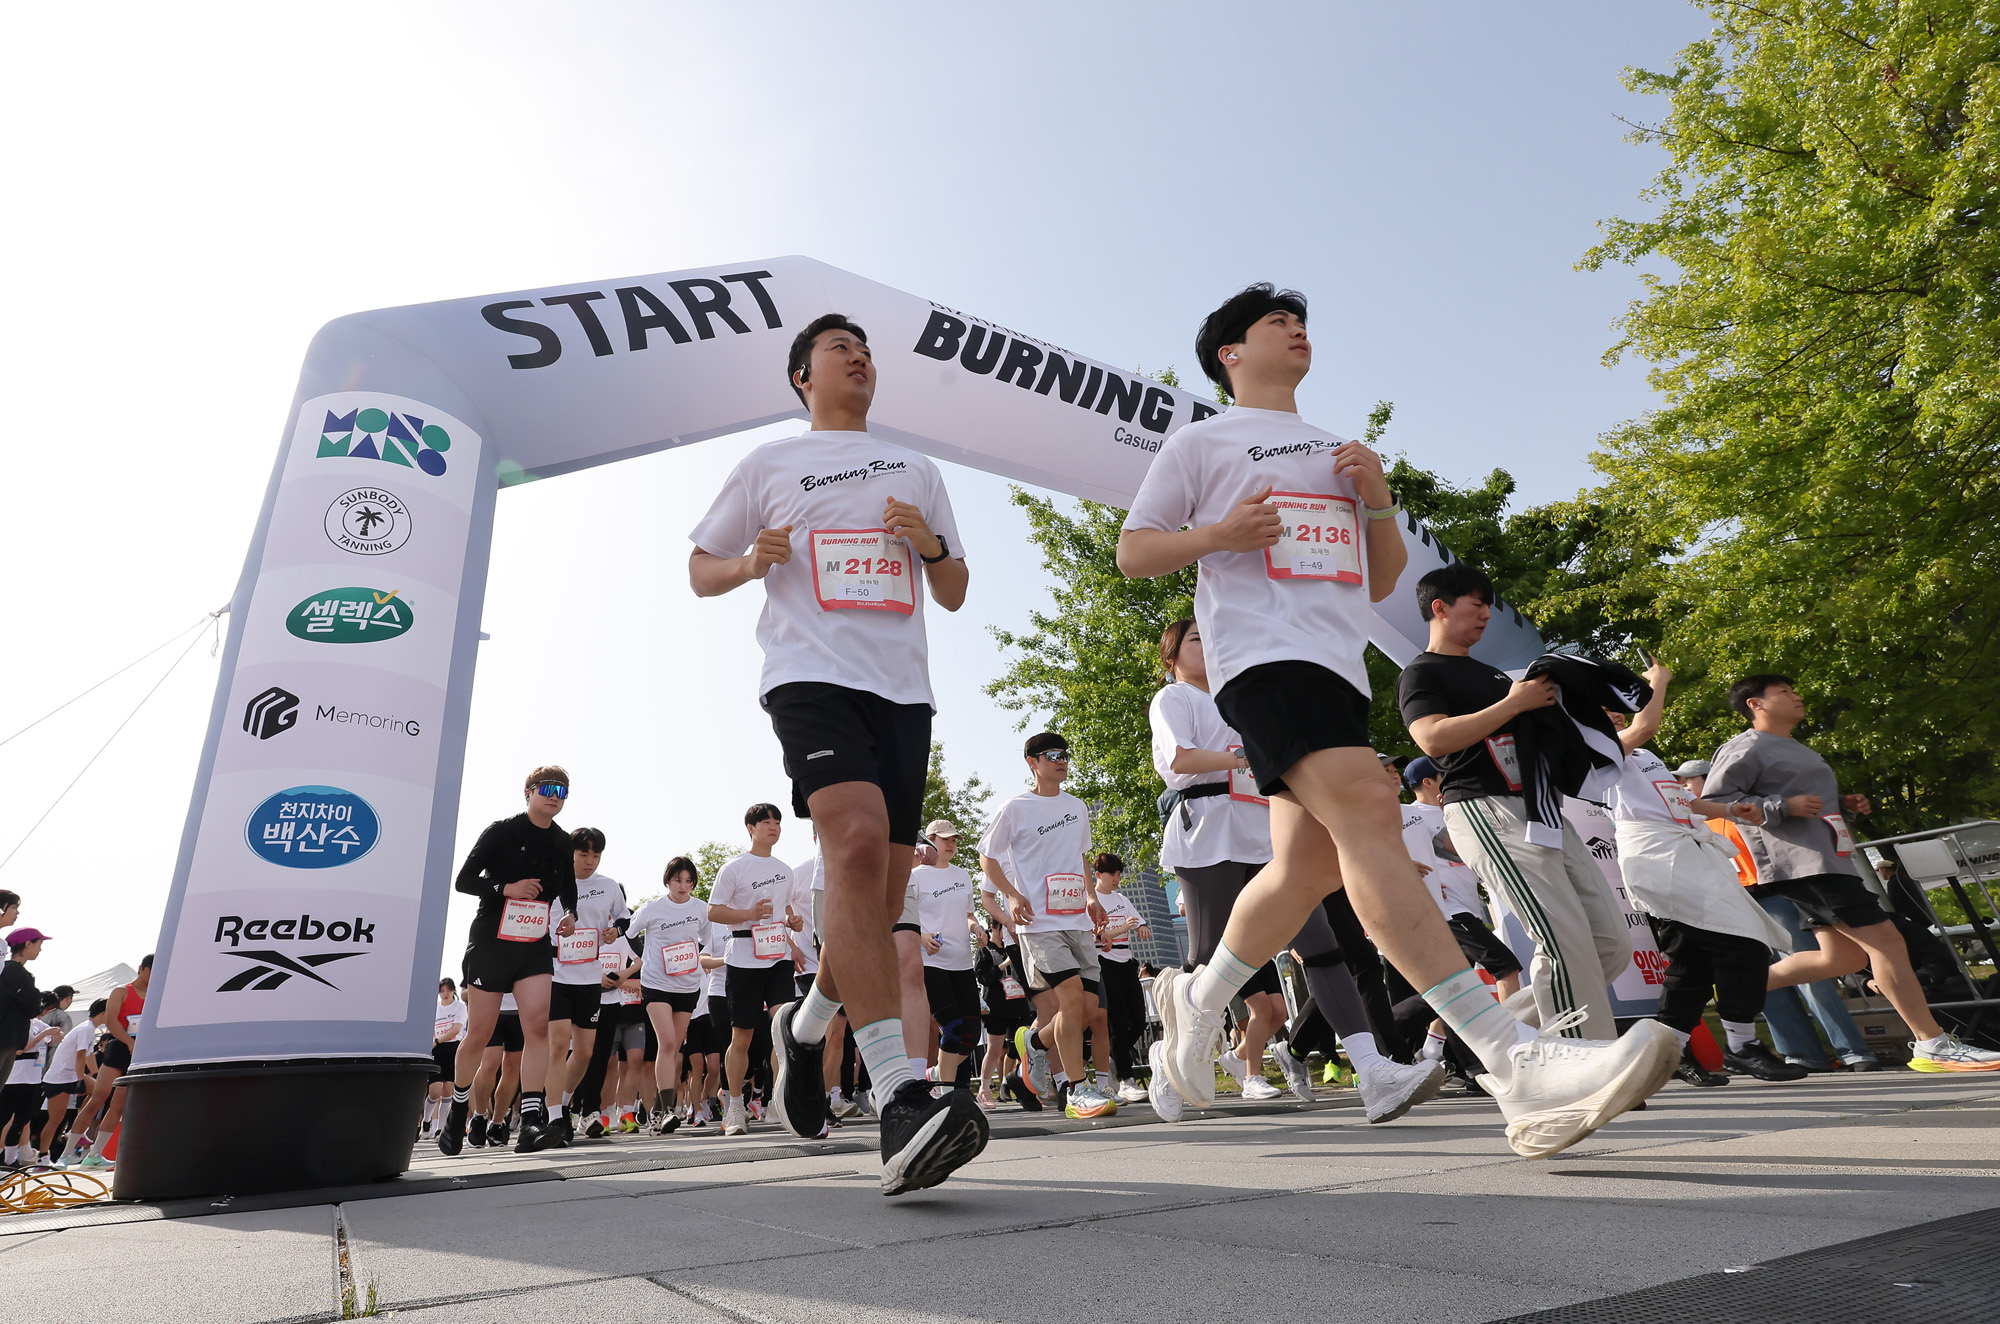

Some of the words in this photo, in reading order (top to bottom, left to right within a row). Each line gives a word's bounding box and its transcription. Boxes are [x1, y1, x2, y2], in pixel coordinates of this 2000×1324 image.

[480, 270, 783, 370] START
[912, 309, 1176, 434] BURNING
[1114, 426, 1163, 453] Casual
[1247, 443, 1312, 461] Burning
[800, 466, 870, 492] Burning
[868, 460, 906, 474] Run
[339, 489, 404, 517] SUNBODY
[1309, 503, 1327, 511] RUN
[337, 533, 392, 552] TANNING
[820, 537, 859, 546] BURNING
[1278, 526, 1292, 537] M
[1296, 524, 1351, 545] 2136
[826, 561, 841, 572] M
[844, 558, 902, 577] 2128
[1299, 561, 1323, 570] F-49
[845, 587, 870, 597] F-50
[300, 597, 403, 633] 셀렉스
[315, 705, 420, 737] MemorinG
[279, 802, 353, 822] 천지차이
[1037, 818, 1065, 836] Burning
[1064, 813, 1079, 824] Run
[262, 823, 361, 855] 백산수
[1061, 888, 1080, 898] 145
[516, 914, 544, 925] 3046
[214, 914, 375, 947] Reebok
[765, 934, 786, 944] 1962
[571, 940, 594, 949] 1089
[674, 952, 694, 963] 3039
